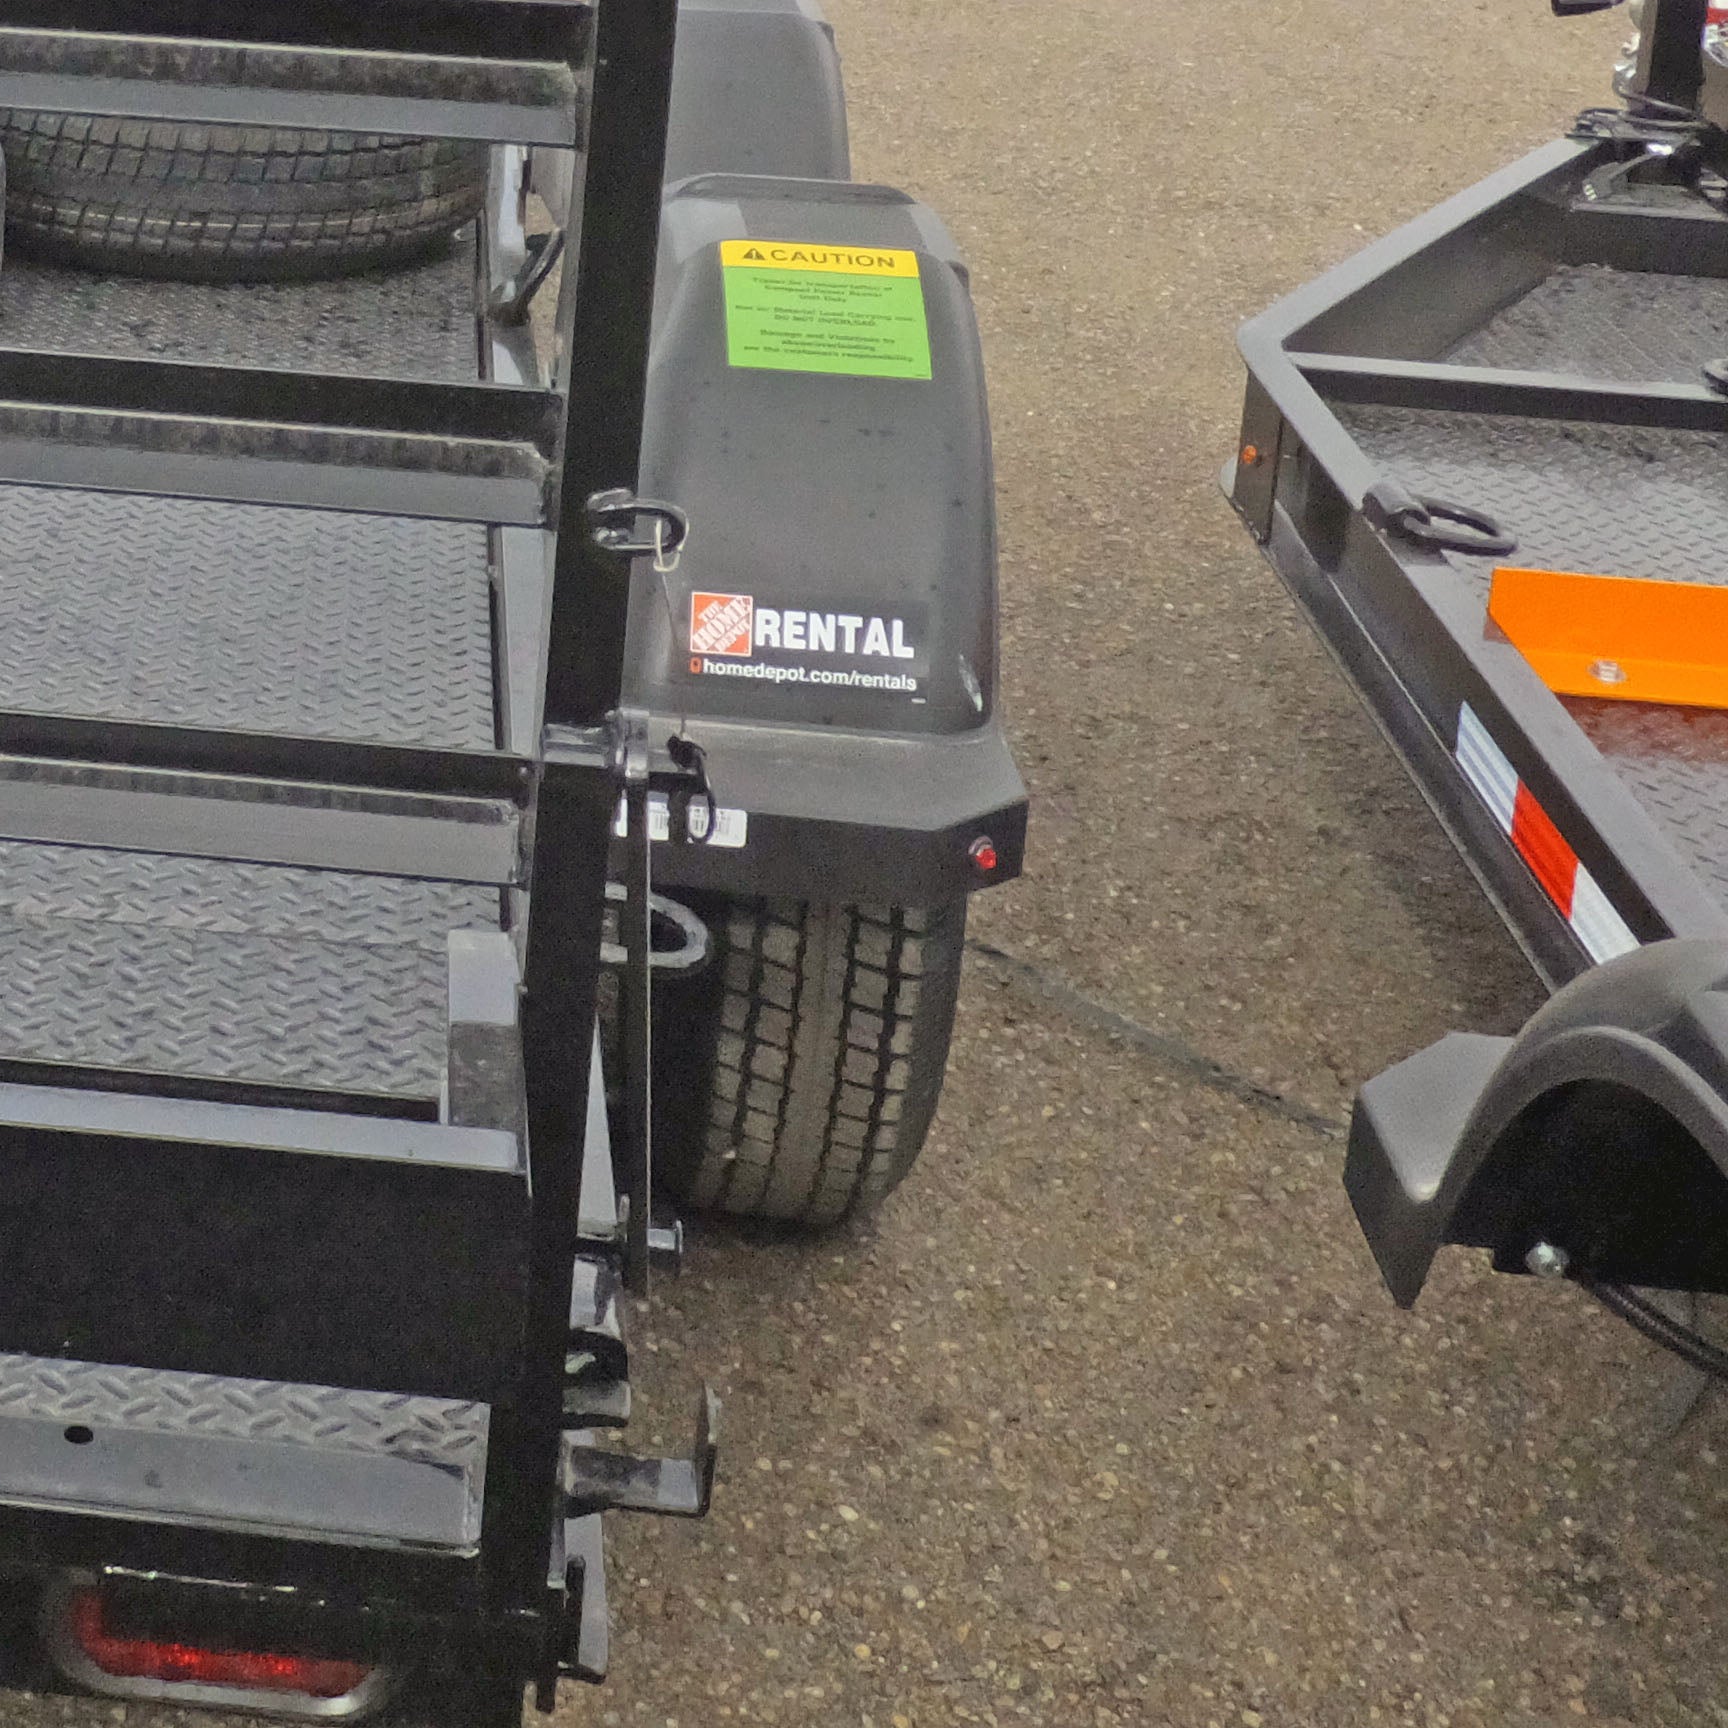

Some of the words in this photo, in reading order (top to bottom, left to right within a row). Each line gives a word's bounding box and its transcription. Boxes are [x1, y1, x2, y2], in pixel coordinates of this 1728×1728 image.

[770, 249, 895, 269] CAUTION
[693, 596, 750, 650] HOME
[755, 609, 915, 658] RENTAL
[703, 658, 917, 691] homedepot.com/rentals
